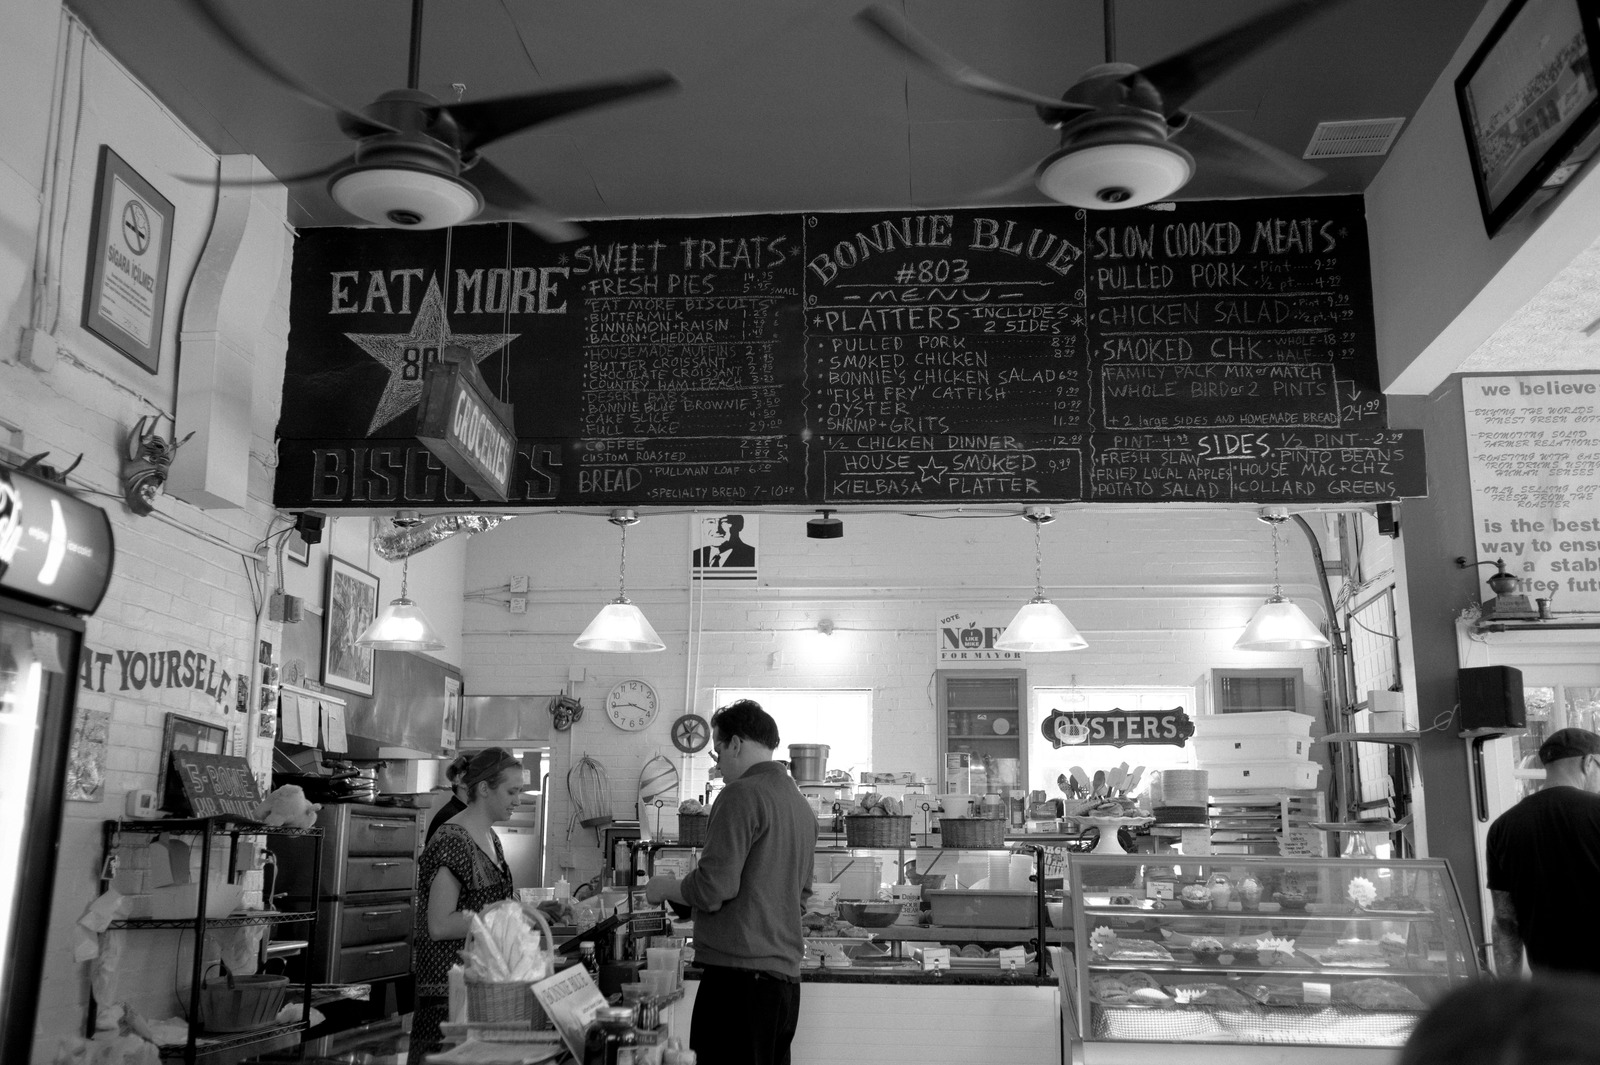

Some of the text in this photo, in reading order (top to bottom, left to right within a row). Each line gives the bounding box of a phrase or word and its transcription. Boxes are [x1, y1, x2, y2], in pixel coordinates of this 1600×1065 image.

[1093, 218, 1337, 260] SLOW COOKED MEATS
[573, 235, 787, 274] SWEET TREATS
[807, 215, 1083, 286] BONNIE BLUE
[895, 259, 970, 283] #803
[1098, 263, 1249, 290] PULLED PORK
[328, 267, 569, 314] EAT MORE
[589, 273, 719, 295] FRESH PIES
[870, 288, 990, 302] MENU
[628, 300, 676, 310] MORE
[590, 310, 684, 322] BUTTERMILK
[826, 307, 960, 331] PLATTERS
[972, 307, 1069, 320] INCLUDES
[1099, 300, 1290, 325] CHICKEN SALAD
[984, 320, 1061, 334] 2 SIDES
[832, 336, 965, 352] PULLED PORK
[1103, 337, 1262, 361] SMOKED CHK
[681, 345, 736, 359] MUFFINS
[589, 357, 727, 371] BUTTER CROISSANT
[830, 351, 988, 369] SMOKED CHICKEN
[589, 366, 742, 380] CHOCOLATE CROISSANT
[830, 367, 1056, 385] BONNIE'S CHICKEN SALAD
[1106, 366, 1321, 380] FAMILY PACK MIX MATCH
[589, 379, 649, 391] COUNTRY
[1109, 381, 1327, 397] WHOLE BIRD 2 PINTS
[1481, 385, 1510, 396] we
[588, 390, 639, 403] DESERT
[932, 386, 1007, 401] CATFISH
[588, 399, 750, 414] BONNIE BLUE BROWNIE
[829, 401, 910, 416] OYSTER
[1548, 406, 1594, 414] WORLDS
[586, 412, 670, 423] CAKE SLICE
[1139, 412, 1338, 428] large SIDES AND HOMEMADE BREAD
[587, 422, 680, 435] FULL CAKE
[1552, 430, 1587, 438] SOLID
[454, 390, 510, 484] GROCERIES
[857, 435, 1018, 450] CHICKEN DINNER
[1114, 435, 1149, 448] PINT
[1314, 434, 1358, 447] PINT
[586, 441, 645, 451] COFFEE
[1198, 433, 1271, 457] SIDES
[583, 451, 686, 462] CUSTOM ROASTED
[844, 454, 1037, 471] HOUSE SMOKED
[1102, 452, 1200, 466] FRESH SLAW
[1281, 450, 1404, 461] PINTO BEANS
[1097, 468, 1231, 480] FRIED LOCAL APPLES
[1240, 464, 1289, 477] HOUSE
[579, 466, 740, 493] BREAD PULLMAN LOAF
[833, 478, 1041, 494] KIELBASA PLATTER
[652, 487, 746, 499] SPECIALTY BREAD
[1098, 482, 1219, 497] POTATO SALAD
[1239, 480, 1396, 497] COLLARD GREENS
[1521, 485, 1569, 493] SELLING
[1570, 492, 1593, 500] THE
[1484, 518, 1600, 533] is the best
[1481, 542, 1524, 556] way
[1531, 539, 1552, 552] to
[1523, 561, 1535, 572] a
[941, 614, 960, 624] VOTE
